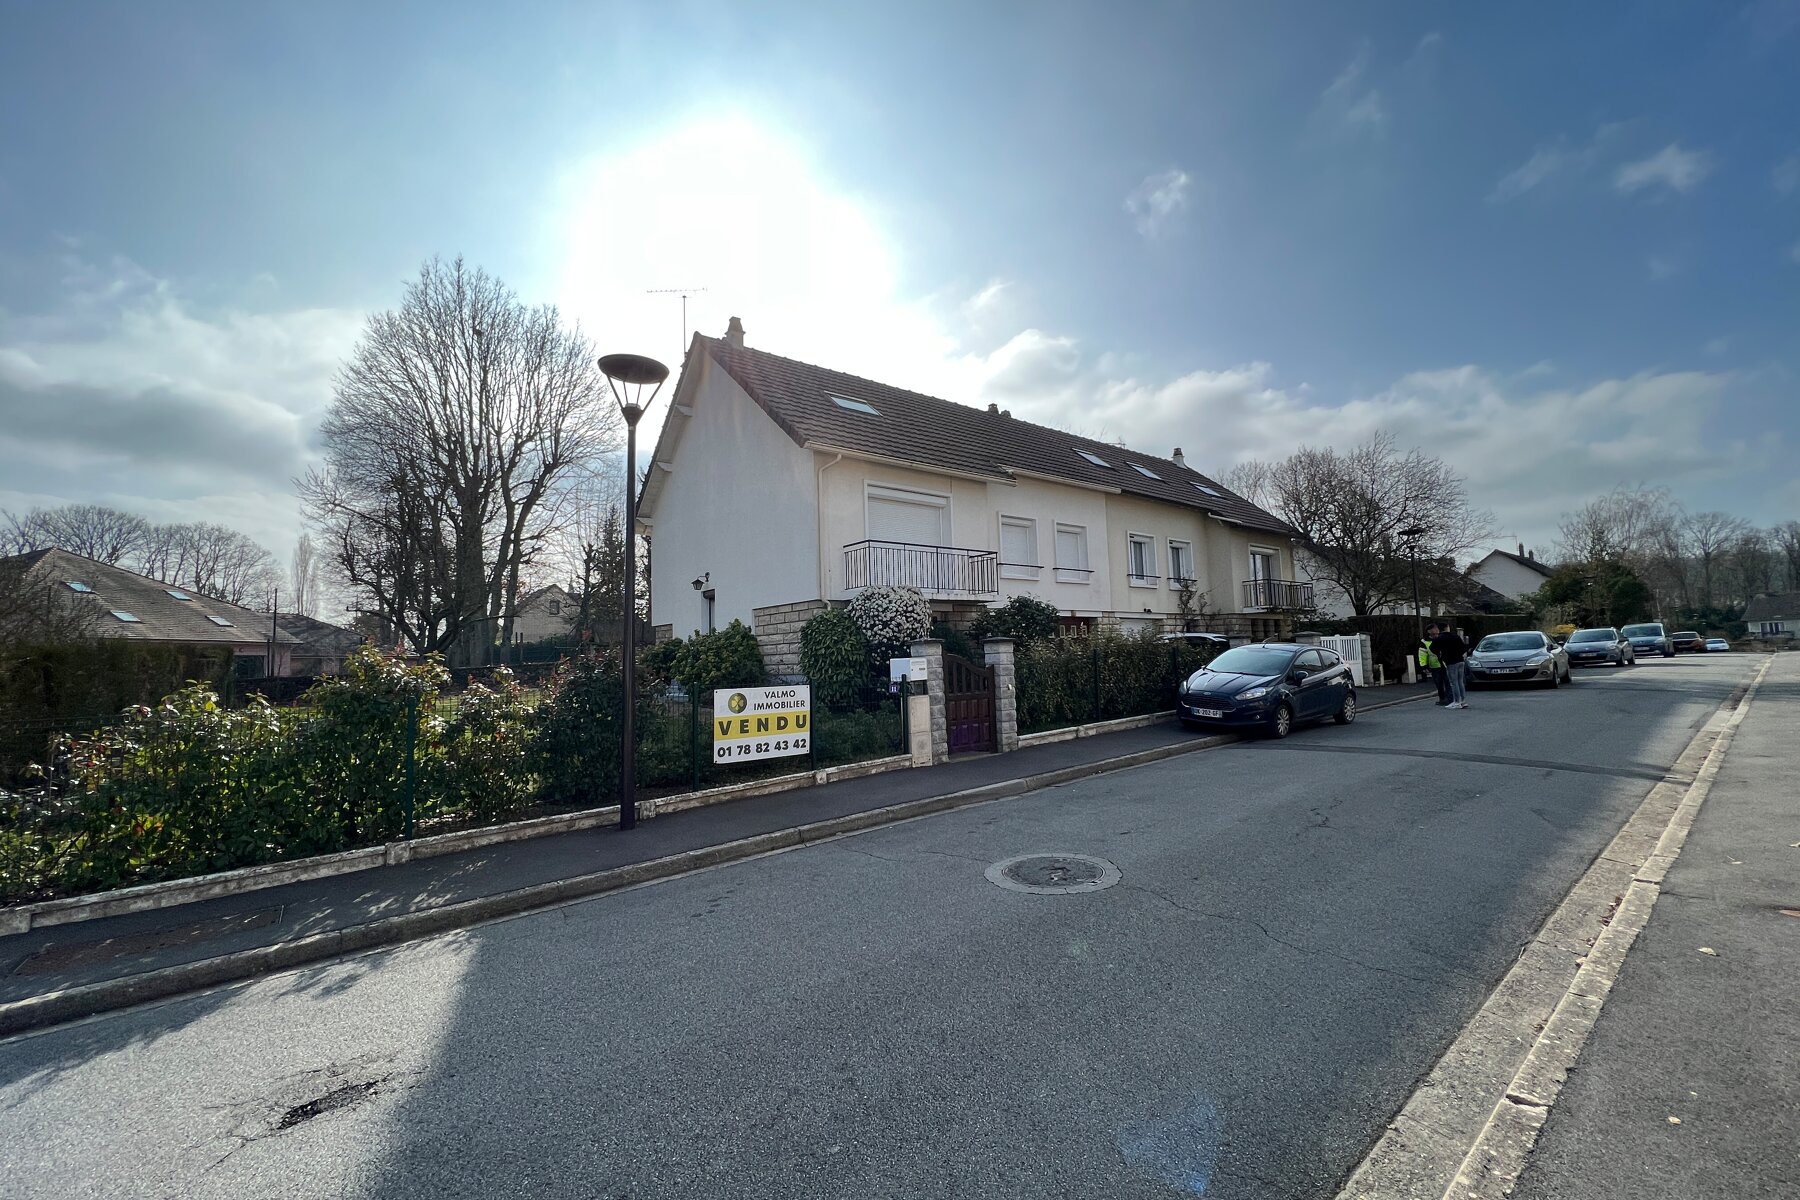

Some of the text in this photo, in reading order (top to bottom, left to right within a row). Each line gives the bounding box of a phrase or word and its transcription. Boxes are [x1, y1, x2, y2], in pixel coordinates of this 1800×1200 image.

[764, 690, 796, 699] VALMO
[754, 700, 806, 711] IMMOBILIER
[718, 714, 807, 736] VENDU
[717, 738, 807, 758] 01 78 82 43 42
